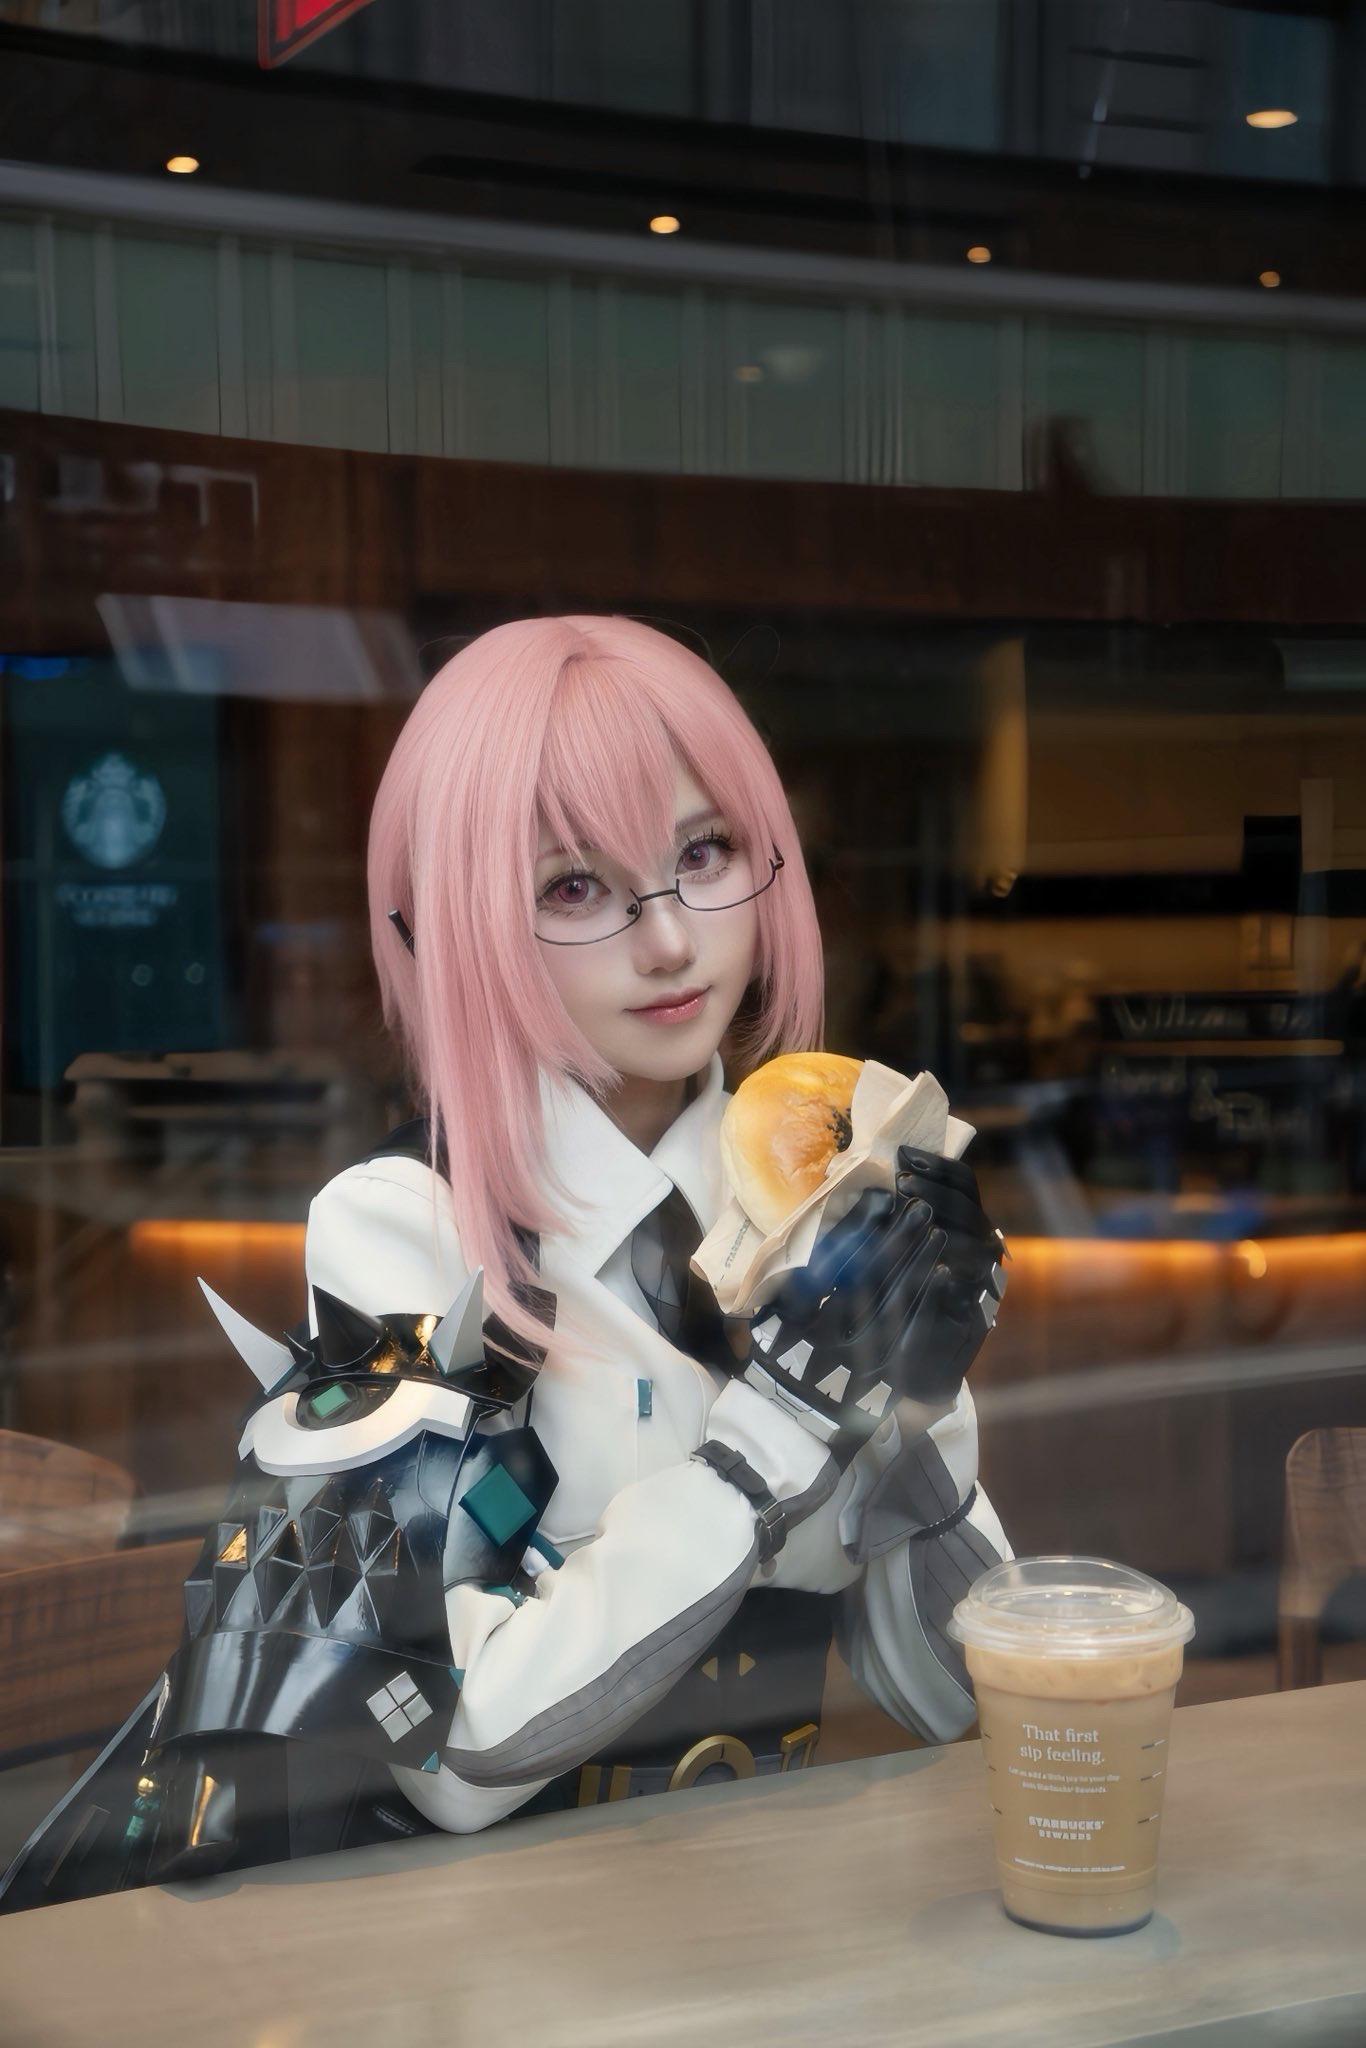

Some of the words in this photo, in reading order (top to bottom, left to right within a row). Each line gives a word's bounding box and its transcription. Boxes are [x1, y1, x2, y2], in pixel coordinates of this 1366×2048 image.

[1022, 1724, 1060, 1742] That
[1065, 1728, 1099, 1743] first
[1020, 1745, 1042, 1762] sip
[1047, 1746, 1105, 1765] feeling.
[1038, 1829, 1092, 1841] REWARDS
